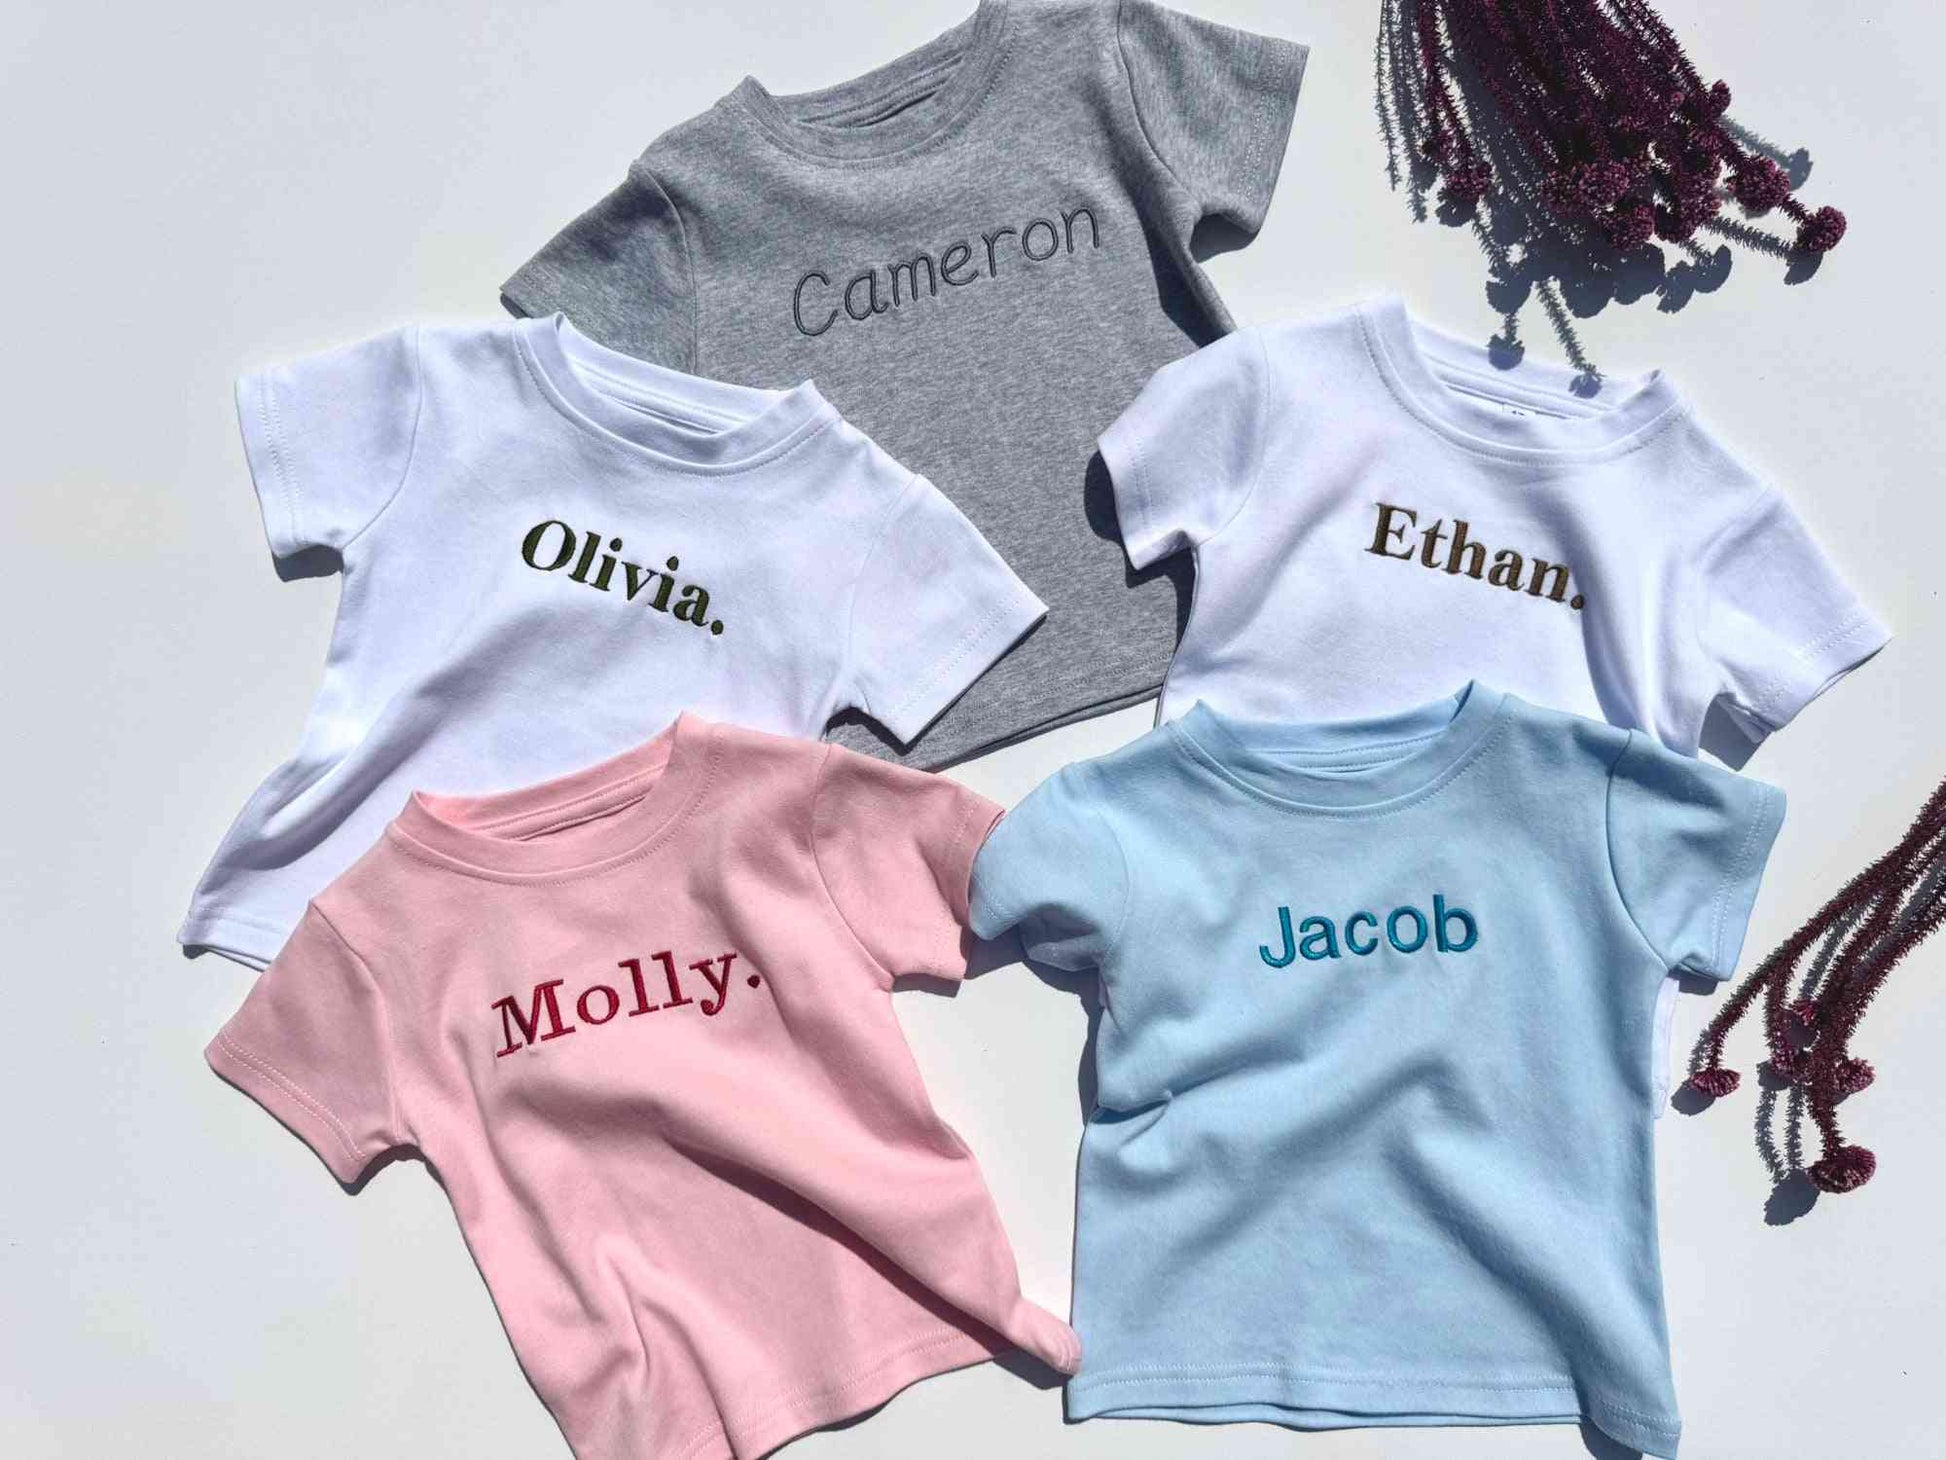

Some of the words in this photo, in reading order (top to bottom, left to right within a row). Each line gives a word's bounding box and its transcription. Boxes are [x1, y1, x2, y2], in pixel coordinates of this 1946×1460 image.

[793, 206, 1100, 336] Cameron
[521, 520, 724, 635] Olivia.
[1364, 502, 1585, 610] Ethan.
[1259, 894, 1479, 969] Jacob
[491, 951, 760, 1058] Molly.
